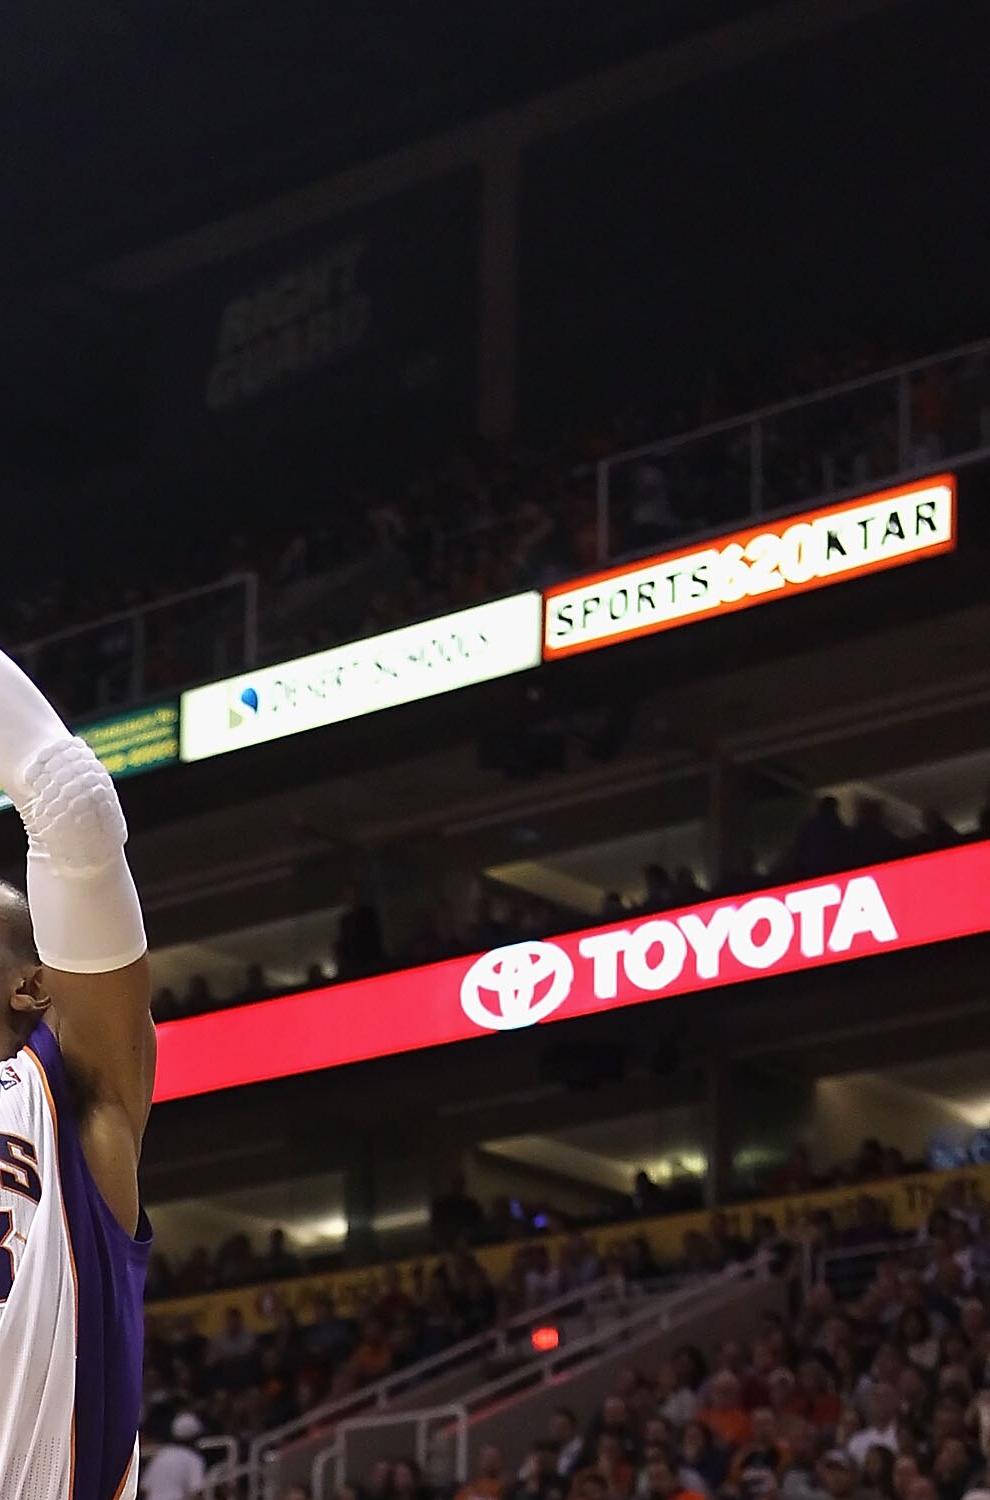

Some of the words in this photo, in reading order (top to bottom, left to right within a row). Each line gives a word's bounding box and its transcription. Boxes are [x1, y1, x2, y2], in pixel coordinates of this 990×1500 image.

[556, 565, 710, 636] SPORTS
[825, 501, 938, 561] KTAR
[579, 876, 898, 999] TOYOTA
